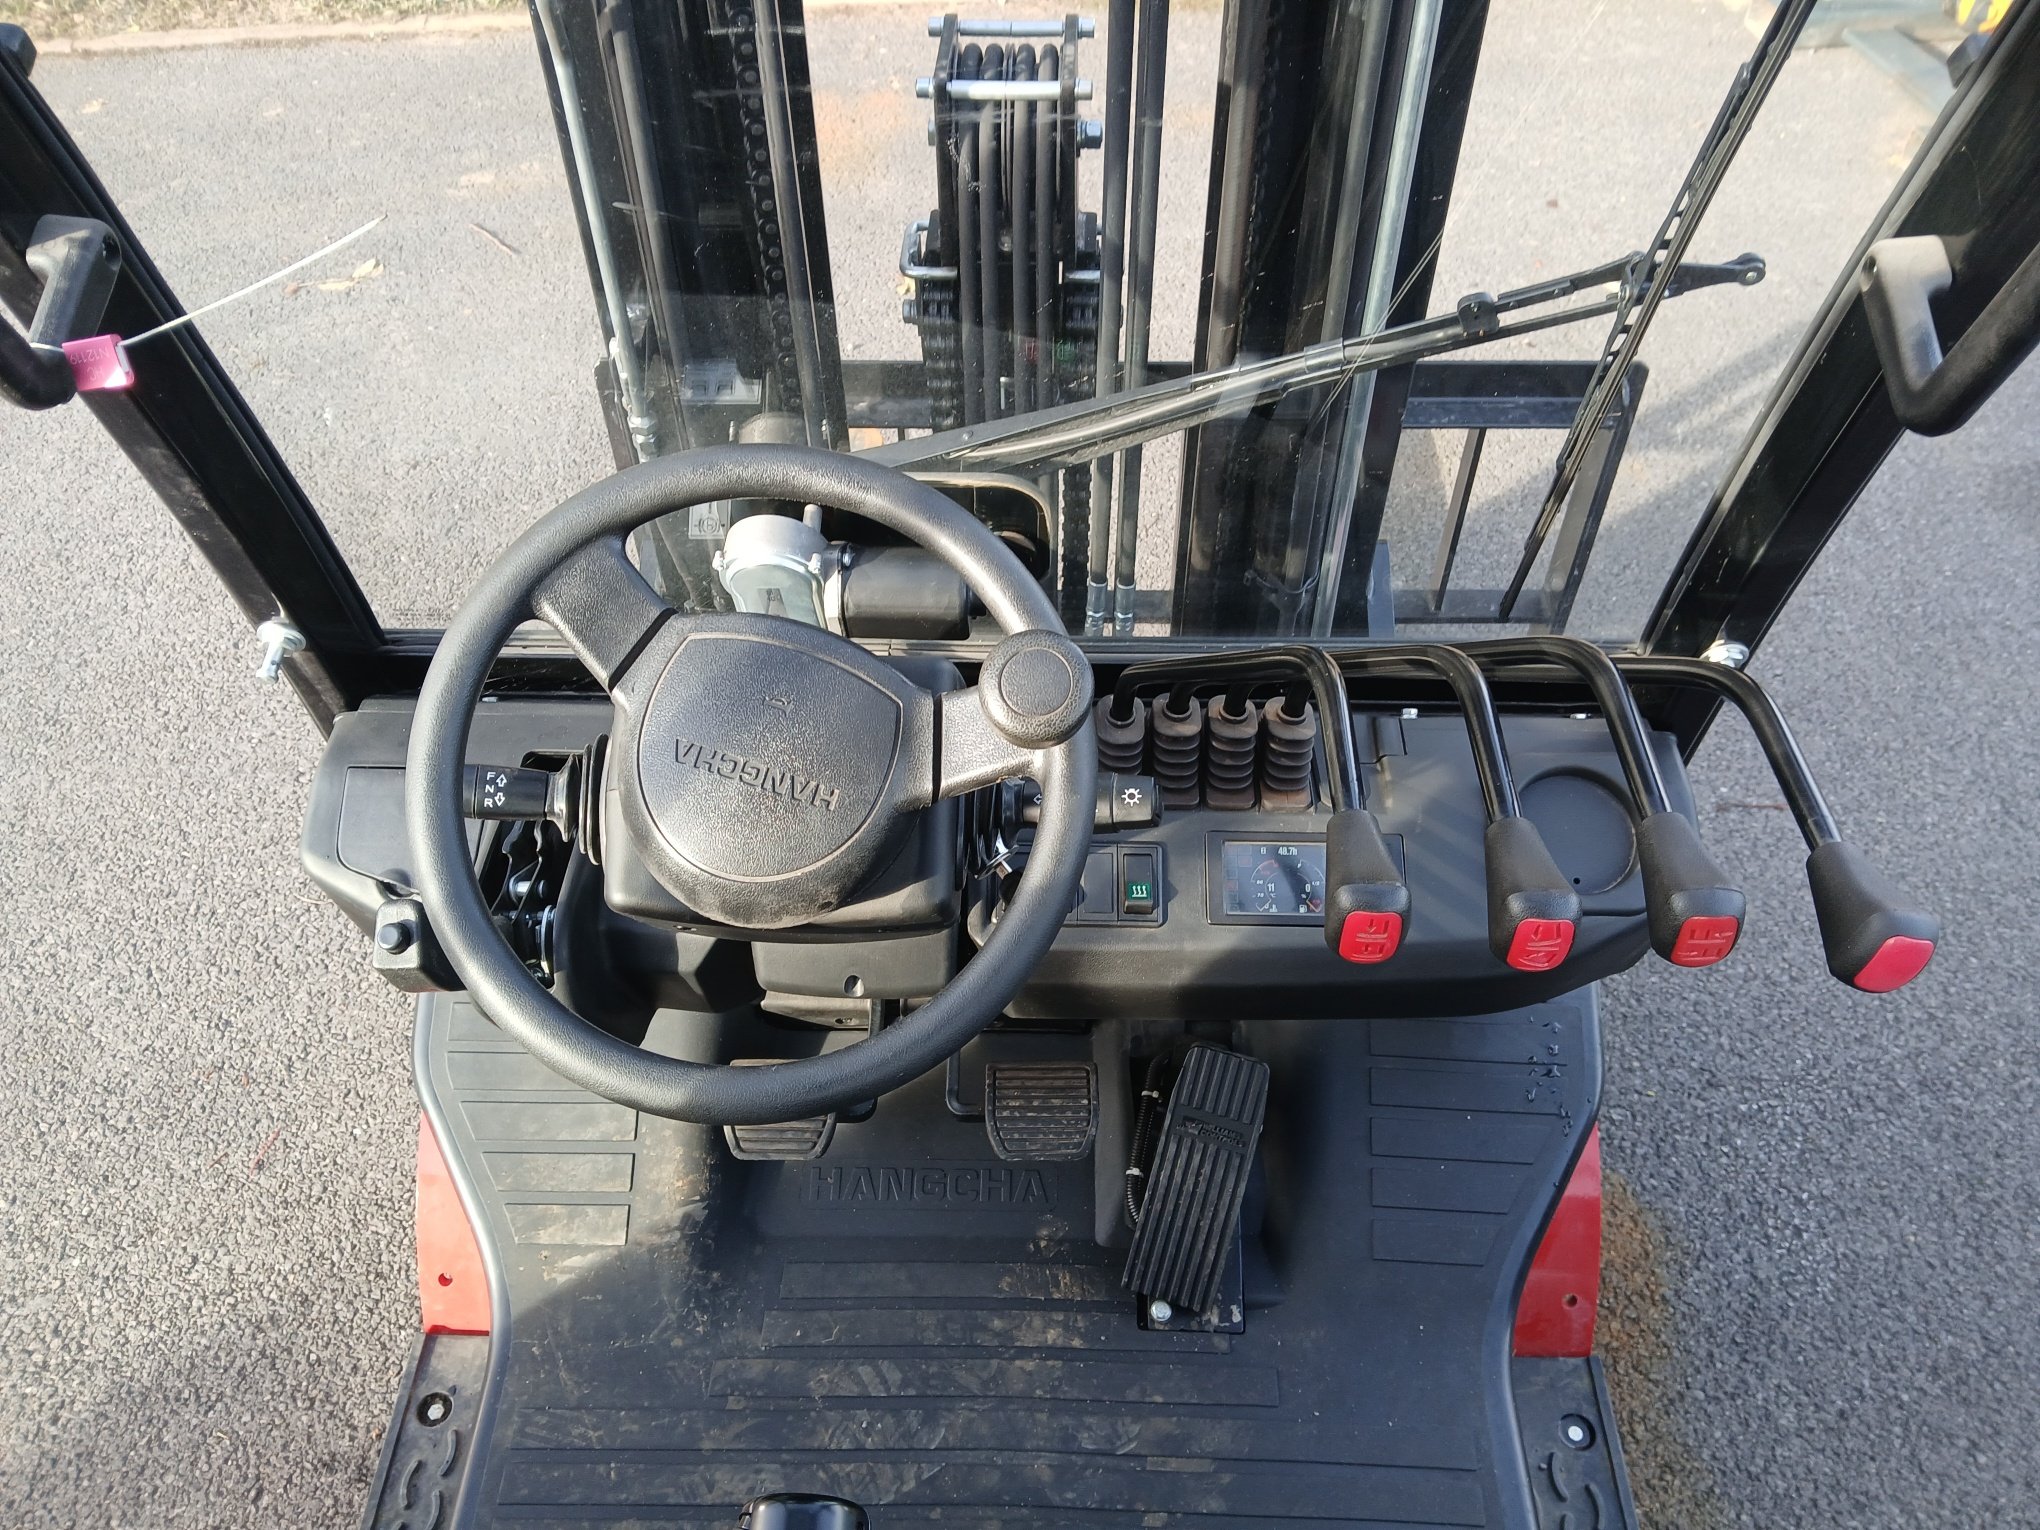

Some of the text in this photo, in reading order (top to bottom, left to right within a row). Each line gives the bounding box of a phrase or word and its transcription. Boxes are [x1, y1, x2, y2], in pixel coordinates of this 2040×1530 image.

[486, 771, 496, 781] F
[675, 738, 840, 812] HANGCHA
[484, 784, 495, 793] N
[483, 798, 493, 808] R
[1267, 882, 1275, 892] 11
[808, 1166, 1049, 1203] HANGCHA
